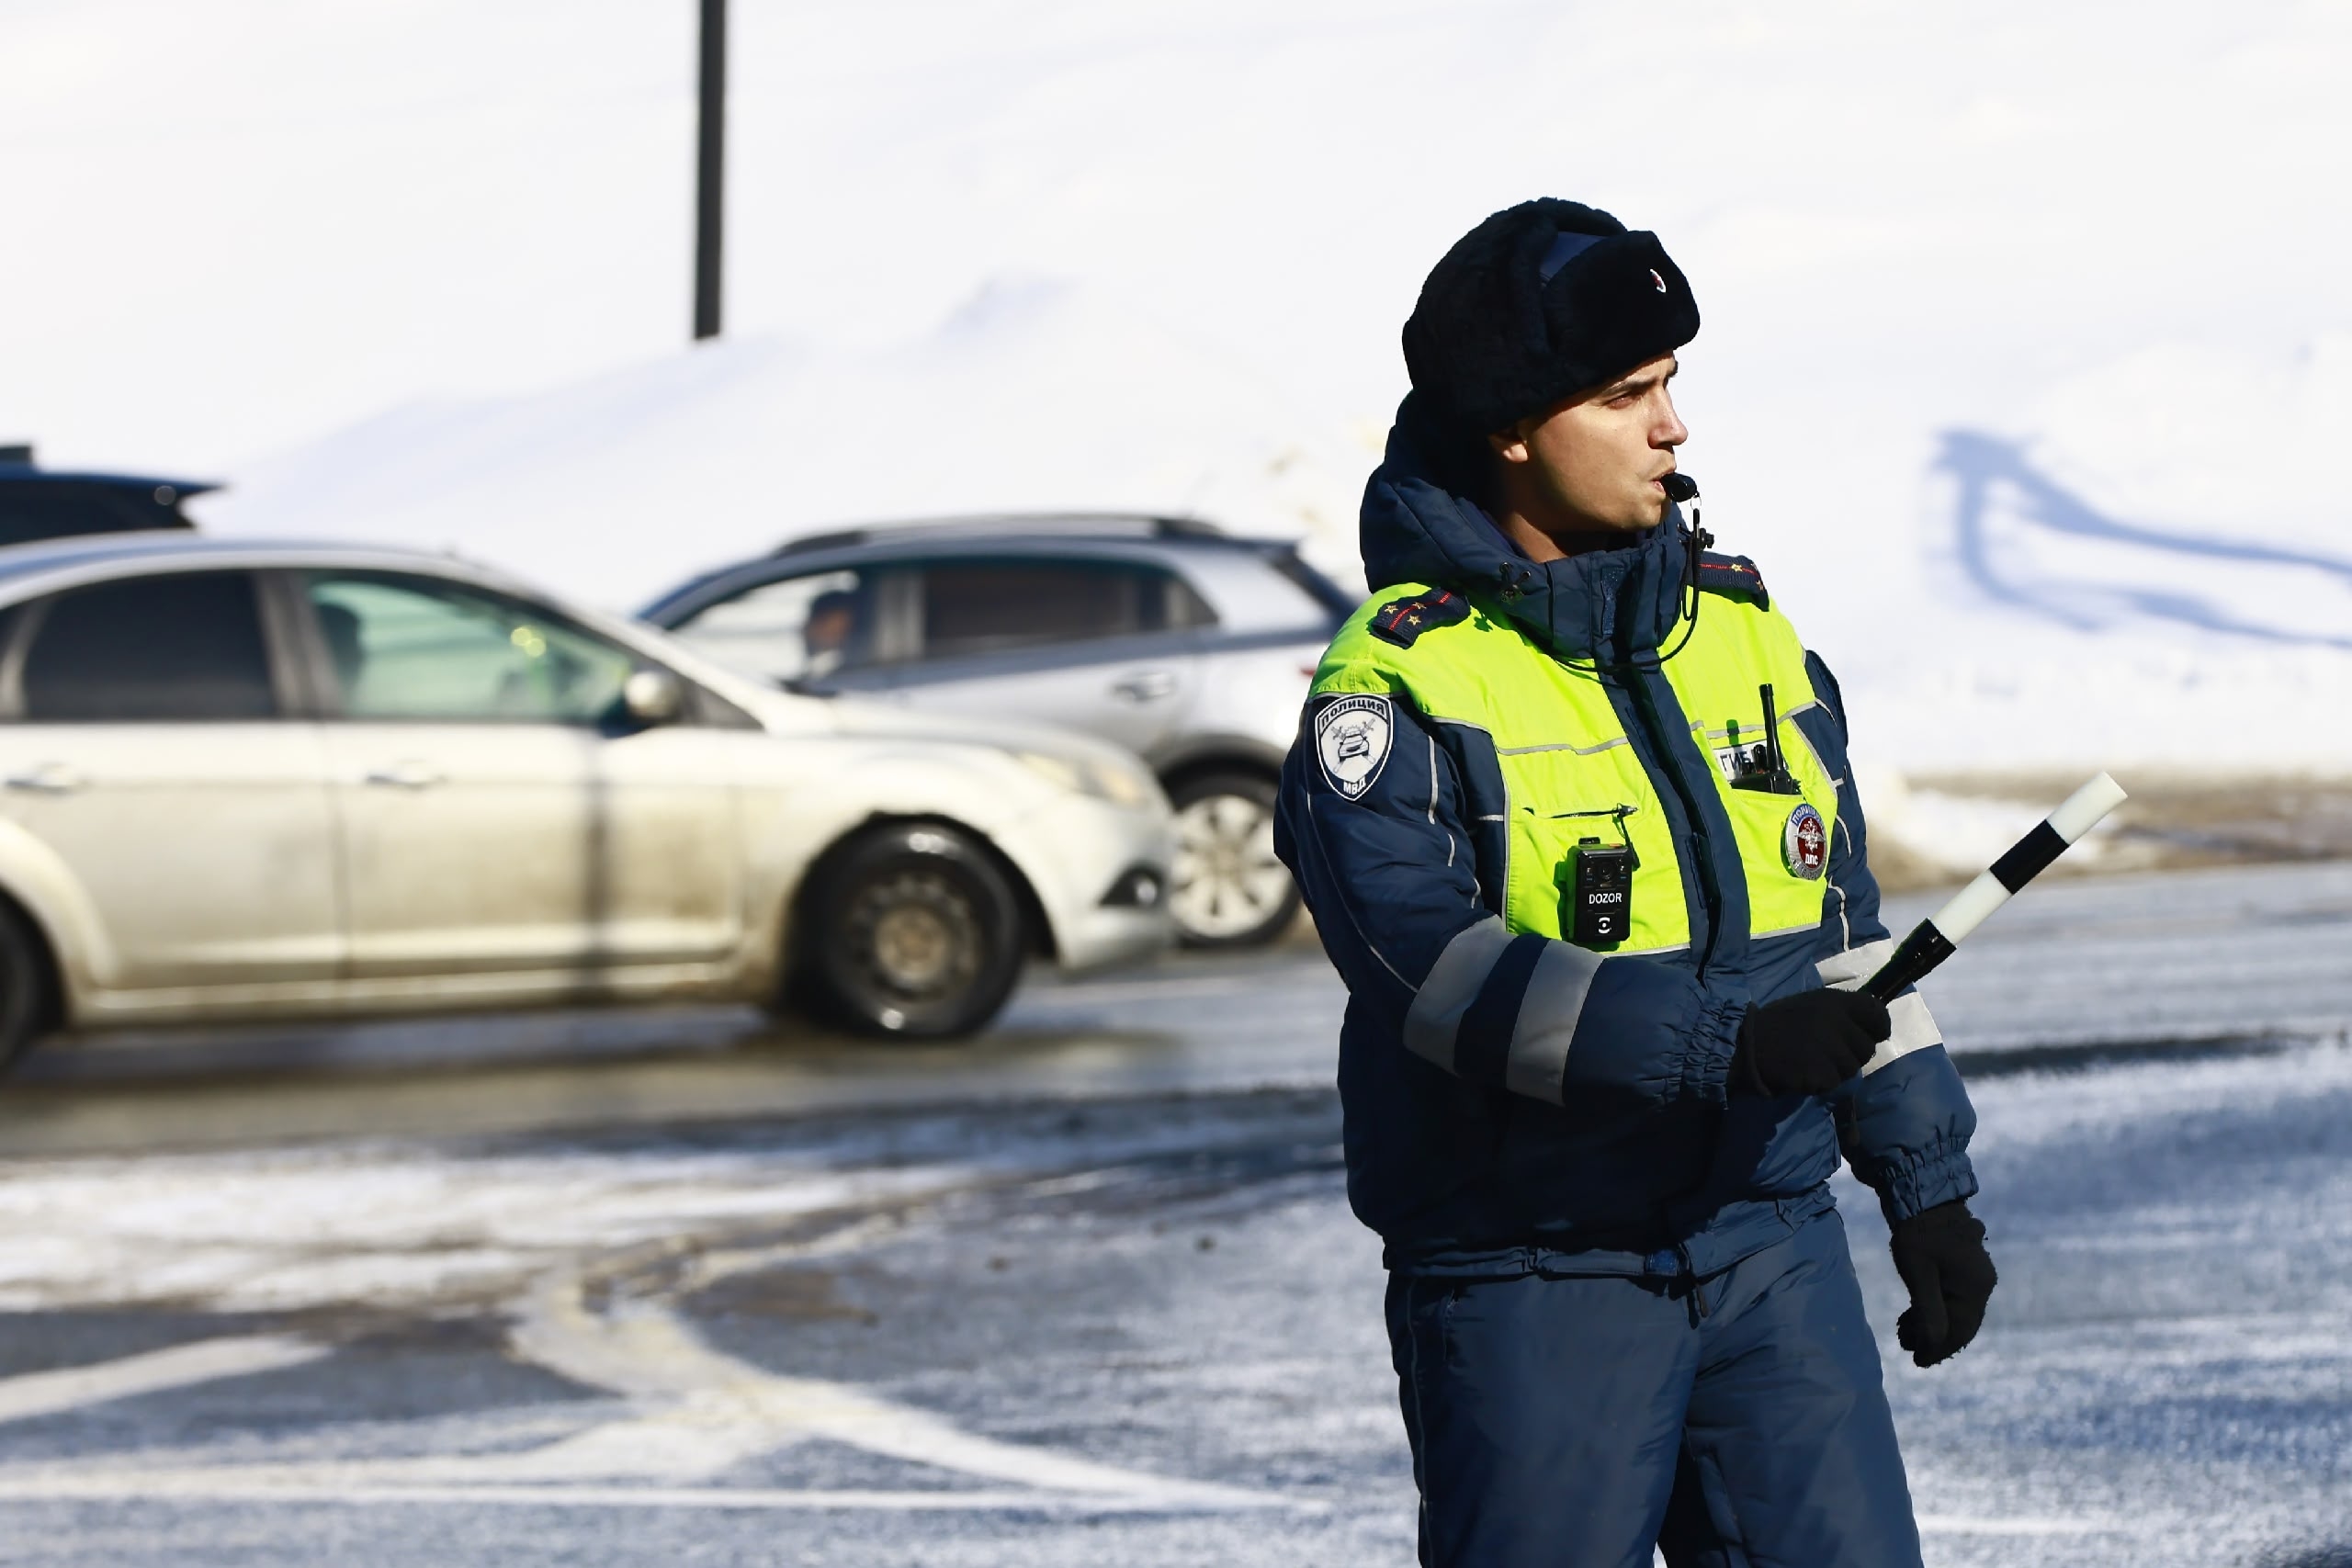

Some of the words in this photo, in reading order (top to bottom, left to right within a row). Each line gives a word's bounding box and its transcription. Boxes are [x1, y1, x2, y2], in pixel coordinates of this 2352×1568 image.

[1322, 699, 1385, 727] ПОЛИЦИЯ
[1720, 751, 1751, 772] ГИБ
[1343, 776, 1366, 795] МВД
[1804, 852, 1818, 865] ДПС
[1589, 892, 1623, 905] DOZOR
